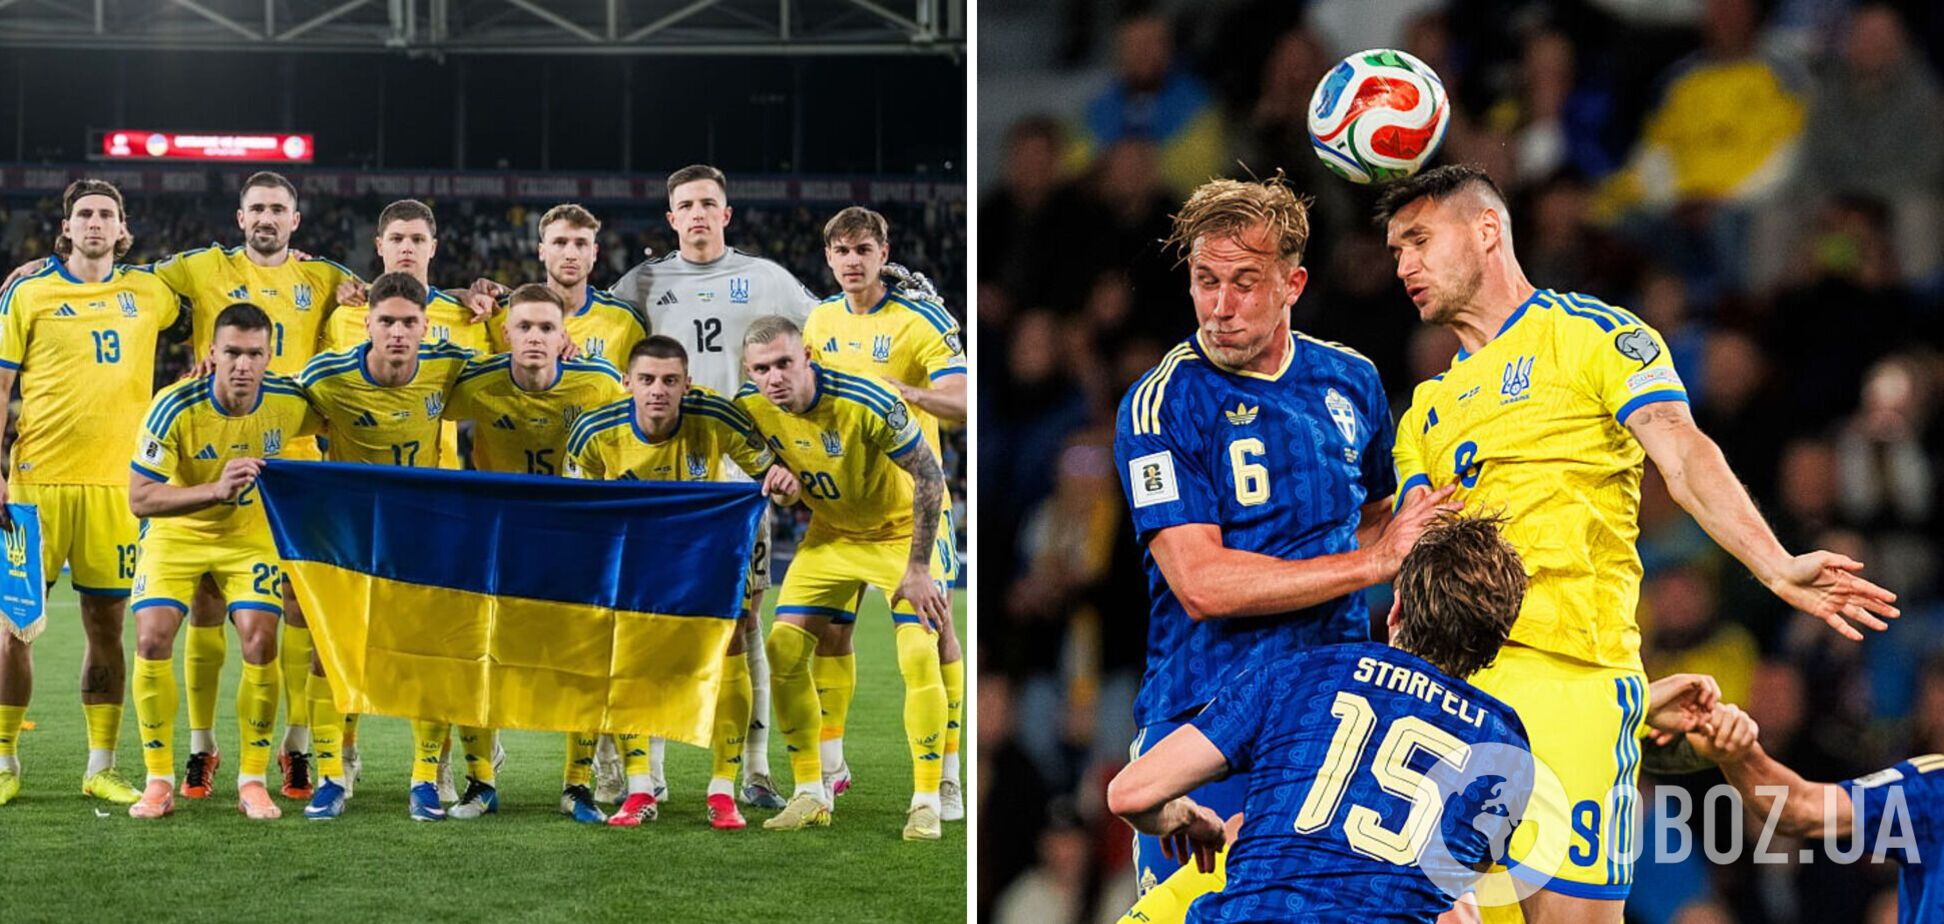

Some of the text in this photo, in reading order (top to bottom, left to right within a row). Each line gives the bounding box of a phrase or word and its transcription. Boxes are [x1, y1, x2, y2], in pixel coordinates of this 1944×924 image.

[90, 329, 121, 364] 13
[693, 318, 723, 353] 12
[800, 471, 841, 501] 20
[1228, 438, 1271, 507] 6
[117, 543, 136, 579] 13
[252, 562, 282, 599] 22
[1294, 691, 1473, 868] 15
